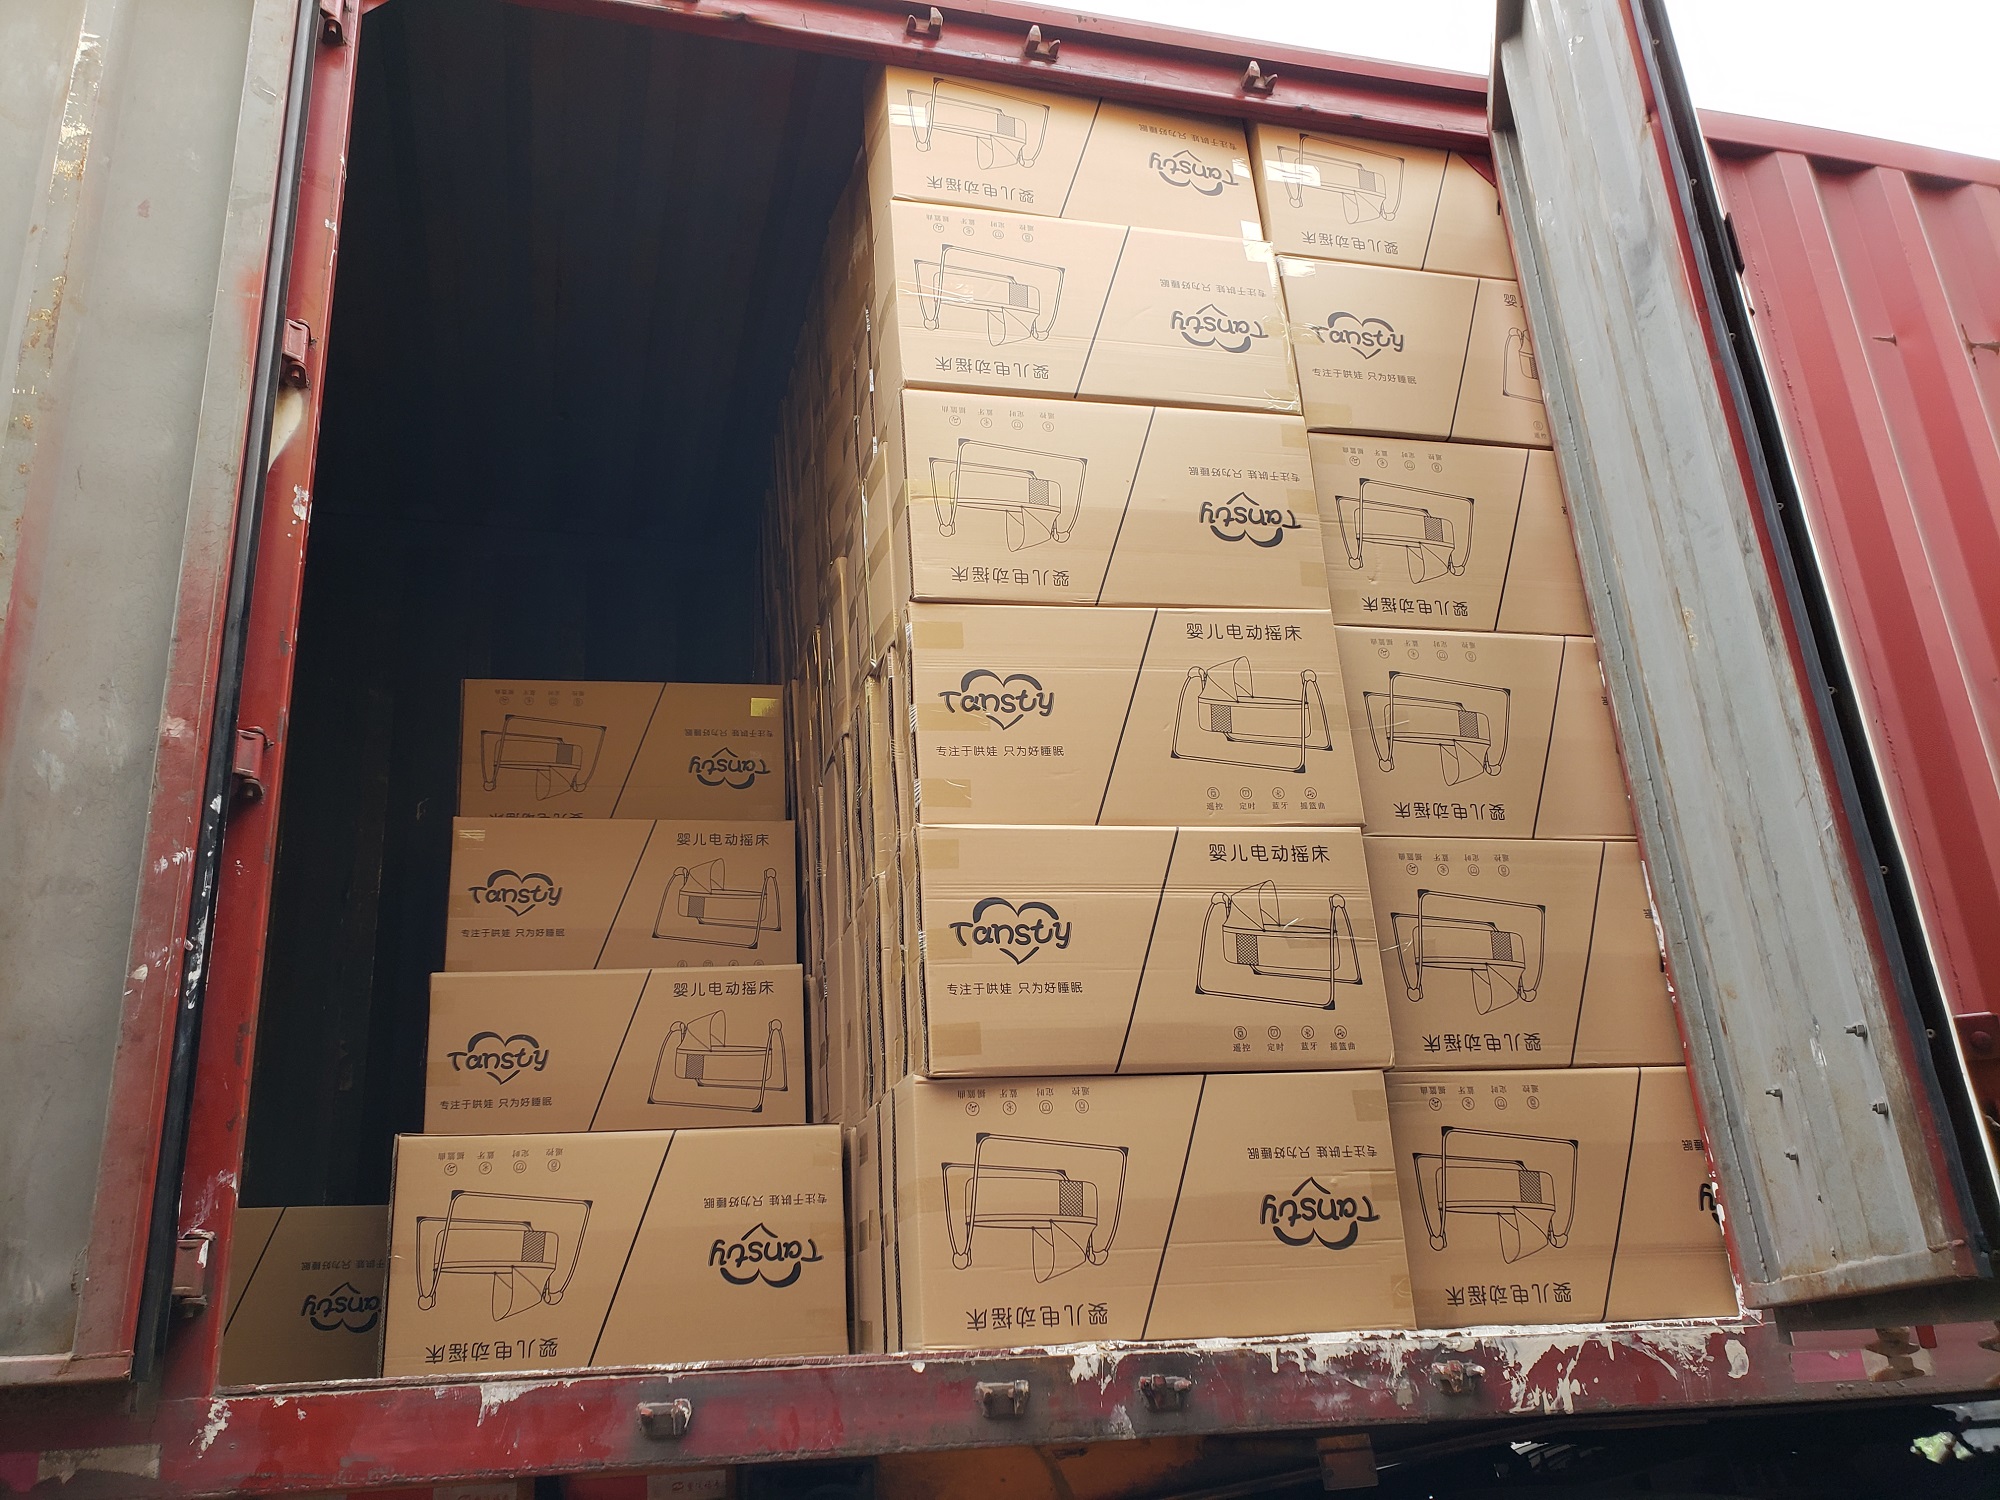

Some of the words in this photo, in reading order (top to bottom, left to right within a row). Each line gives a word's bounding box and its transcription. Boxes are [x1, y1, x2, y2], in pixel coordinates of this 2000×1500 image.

[1149, 151, 1239, 186] Tansty
[926, 175, 1034, 204] 婴儿电动摇床
[1302, 231, 1398, 254] 婴儿电动摇床
[1170, 309, 1269, 340] Tansty
[935, 357, 1049, 379] 婴儿电动摇床
[1312, 368, 1363, 379] 专注于哄娃
[1368, 372, 1416, 384] 只为好睡眠
[1189, 467, 1242, 478] 只为好睡眠
[1247, 470, 1300, 482] 专注于哄娃
[1200, 501, 1302, 529] Tansty
[951, 566, 1069, 586] 婴儿电动摇床
[1362, 597, 1468, 616] 婴儿电动摇床
[1187, 623, 1302, 641] 婴儿电动摇床
[938, 690, 1054, 717] Tansty
[936, 746, 997, 756] 专注于哄娃
[1004, 746, 1064, 756] 只为好睡眠
[688, 756, 770, 776] Tansty
[1394, 802, 1505, 820] 婴儿电动摇床
[677, 833, 768, 846] 婴儿电动摇床
[1210, 844, 1329, 863] 婴儿电动摇床
[468, 885, 563, 907] Tansty
[461, 928, 510, 937] 专注于哄娃
[515, 929, 565, 937] 只为好睡眠
[949, 919, 1073, 949] Tansty
[674, 981, 773, 997] 婴儿电动摇床
[947, 983, 1012, 995] 专注于哄娃
[1019, 982, 1082, 994] 只为好睡眠
[1233, 1043, 1251, 1052] 遥控
[1267, 1042, 1284, 1051] 定时
[1301, 1042, 1317, 1050] 蓝牙
[1330, 1042, 1355, 1050] 摇篮曲
[1422, 1033, 1541, 1052] 婴儿电动摇床
[447, 1048, 549, 1072] Tansty
[440, 1099, 493, 1110] 专注于哄娃
[498, 1097, 552, 1108] 只为好睡眠
[1247, 1147, 1309, 1159] 只为好睡眠
[1316, 1145, 1377, 1158] 专注于哄娃
[704, 1195, 763, 1208] 只为好睡眠
[769, 1193, 827, 1205] 专注于哄娃
[1260, 1194, 1380, 1227] Tansty
[708, 1238, 824, 1267] Tansty
[1446, 1282, 1571, 1306] 婴儿电动摇床
[301, 1294, 381, 1317] ansty
[966, 1303, 1108, 1331] 婴儿电动摇床
[425, 1338, 558, 1364] 婴儿电动摇床
